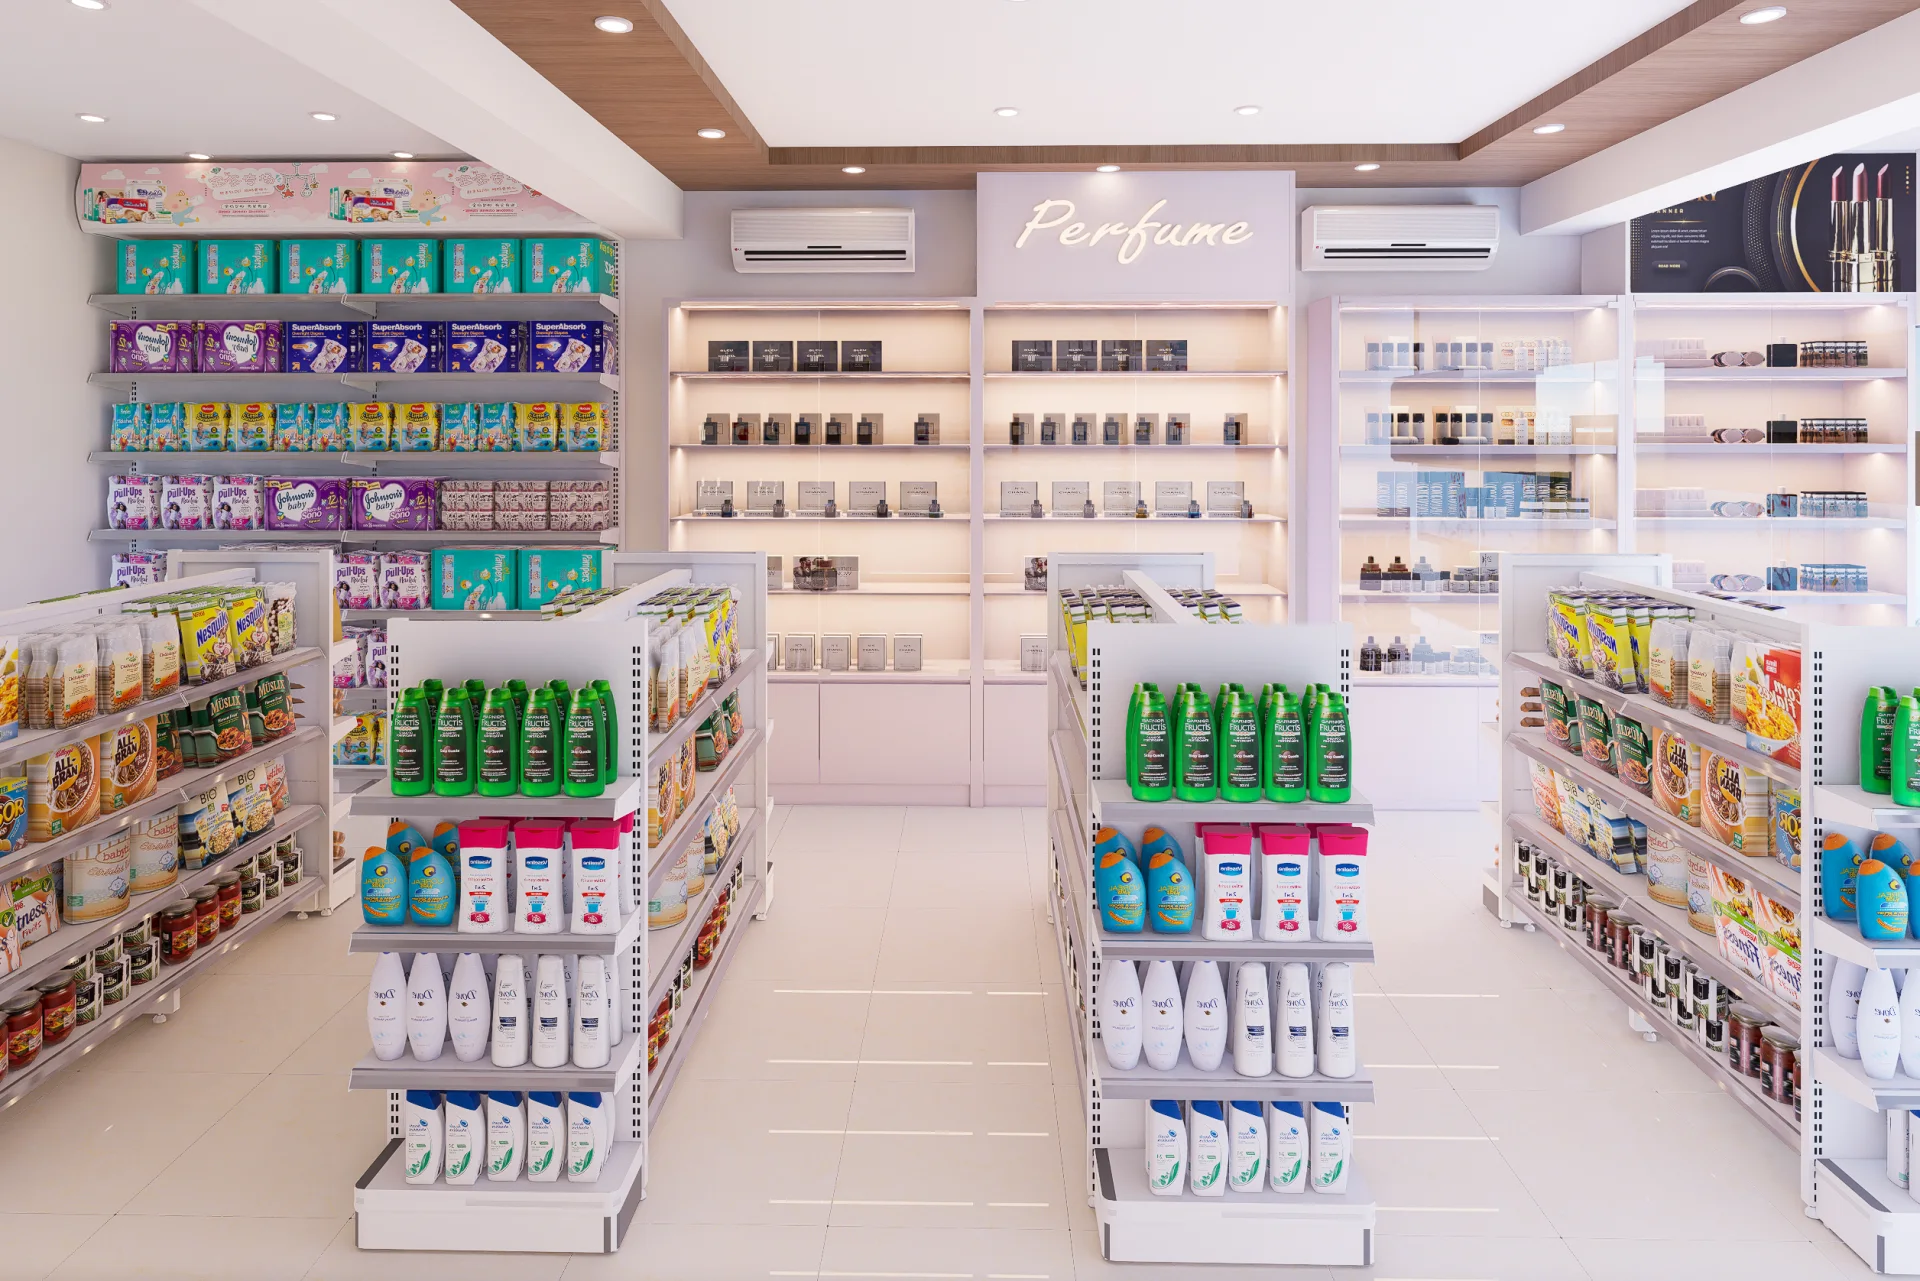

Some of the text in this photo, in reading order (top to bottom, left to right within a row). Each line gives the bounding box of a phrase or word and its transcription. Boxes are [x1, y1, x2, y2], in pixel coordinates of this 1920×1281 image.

[1015, 199, 1253, 264] Perfume
[292, 324, 342, 332] SuperAbsorb
[372, 324, 422, 332] SuperAbsorb
[277, 489, 314, 509] Johnson's
[365, 489, 402, 509] Johnson's
[236, 602, 264, 635] Nesquik
[197, 611, 228, 647] Nesquik
[373, 646, 386, 660] Pull
[258, 679, 285, 699] MÜSLIX
[211, 695, 241, 716] MÜSLIX
[157, 713, 170, 724] LIX
[117, 735, 136, 751] ALL-
[115, 744, 137, 766] BRAN
[54, 756, 76, 776] ALL-
[52, 765, 78, 791] BRAN
[16, 902, 47, 931] tness
